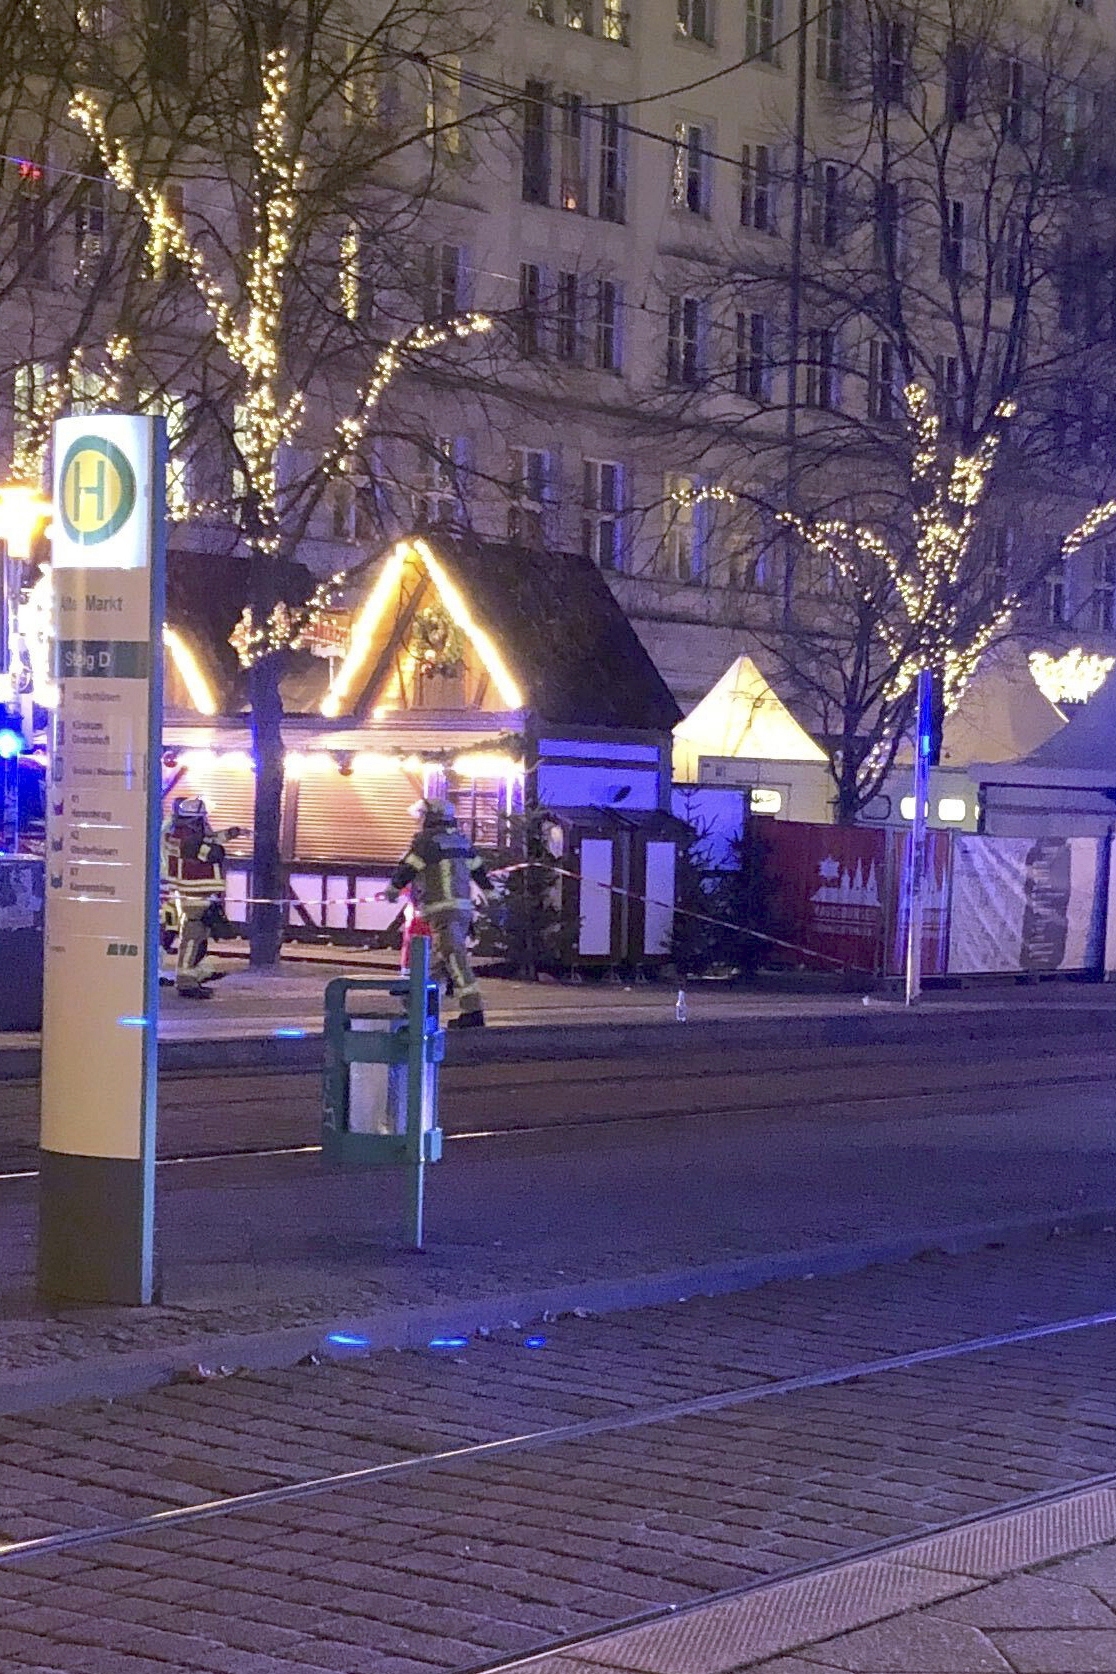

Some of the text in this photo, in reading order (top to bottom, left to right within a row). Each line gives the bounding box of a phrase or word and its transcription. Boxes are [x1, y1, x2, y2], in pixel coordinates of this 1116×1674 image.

[73, 461, 104, 521] H
[85, 594, 123, 612] Markt
[98, 651, 112, 668] D
